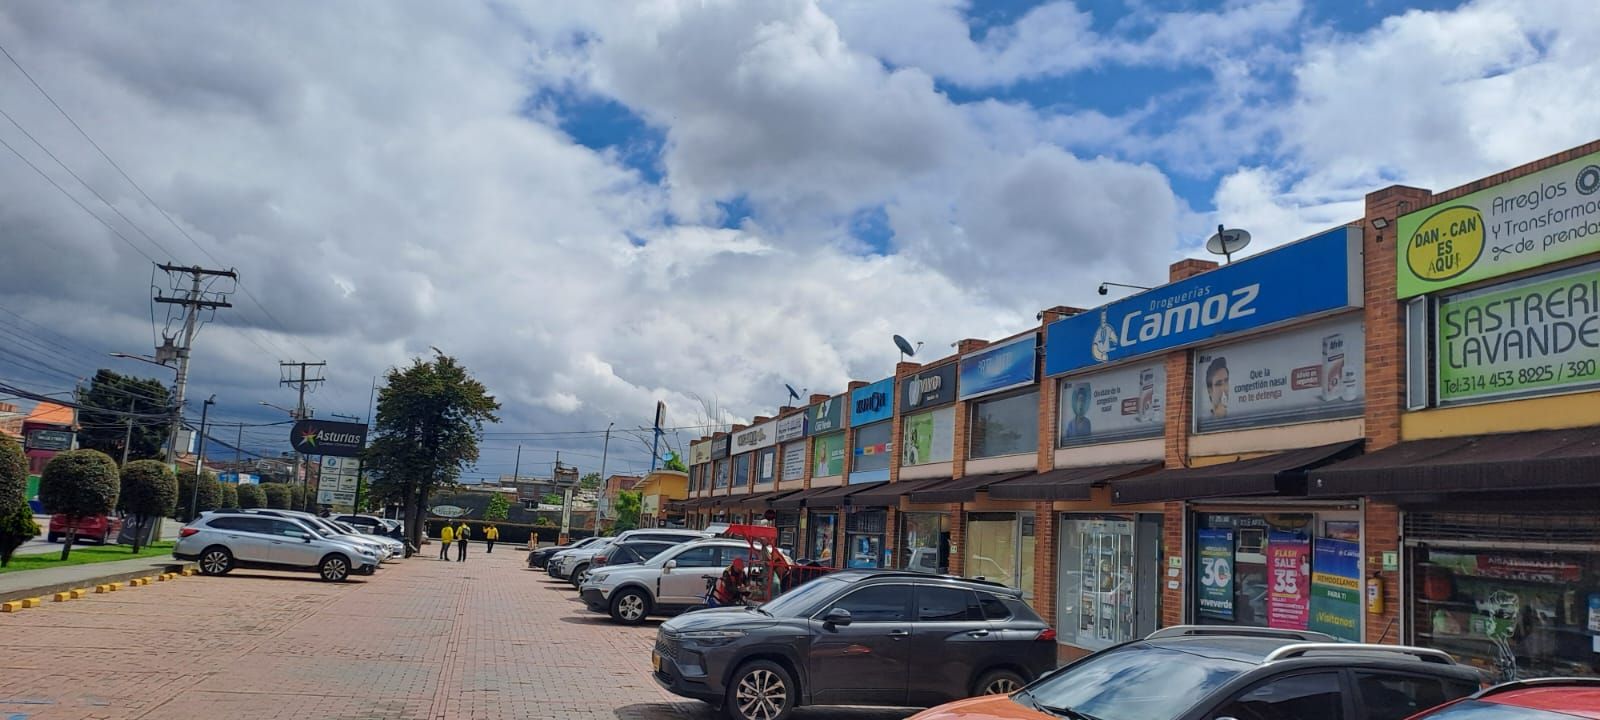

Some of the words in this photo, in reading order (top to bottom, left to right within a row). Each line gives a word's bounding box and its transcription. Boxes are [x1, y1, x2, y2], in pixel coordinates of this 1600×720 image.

[1492, 183, 1567, 216] Arreglos
[1415, 228, 1439, 248] DAN
[1450, 216, 1476, 237] CAN
[1504, 201, 1600, 237] Transforma
[1437, 240, 1453, 257] ES
[1515, 237, 1535, 253] de
[1543, 221, 1600, 252] prenda
[1120, 283, 1260, 348] Camoz
[1234, 380, 1268, 394] congestión
[1270, 376, 1288, 387] nasal
[1250, 369, 1263, 380] Que
[1264, 368, 1271, 377] la
[1489, 371, 1514, 388] 453
[1518, 365, 1554, 384] 8225
[1567, 359, 1596, 378] 320
[1238, 395, 1246, 403] no
[1256, 389, 1283, 401] detenga
[316, 430, 361, 444] Asturias
[1201, 558, 1231, 587] 30
[1274, 558, 1297, 569] SALE
[1274, 569, 1298, 593] 35
